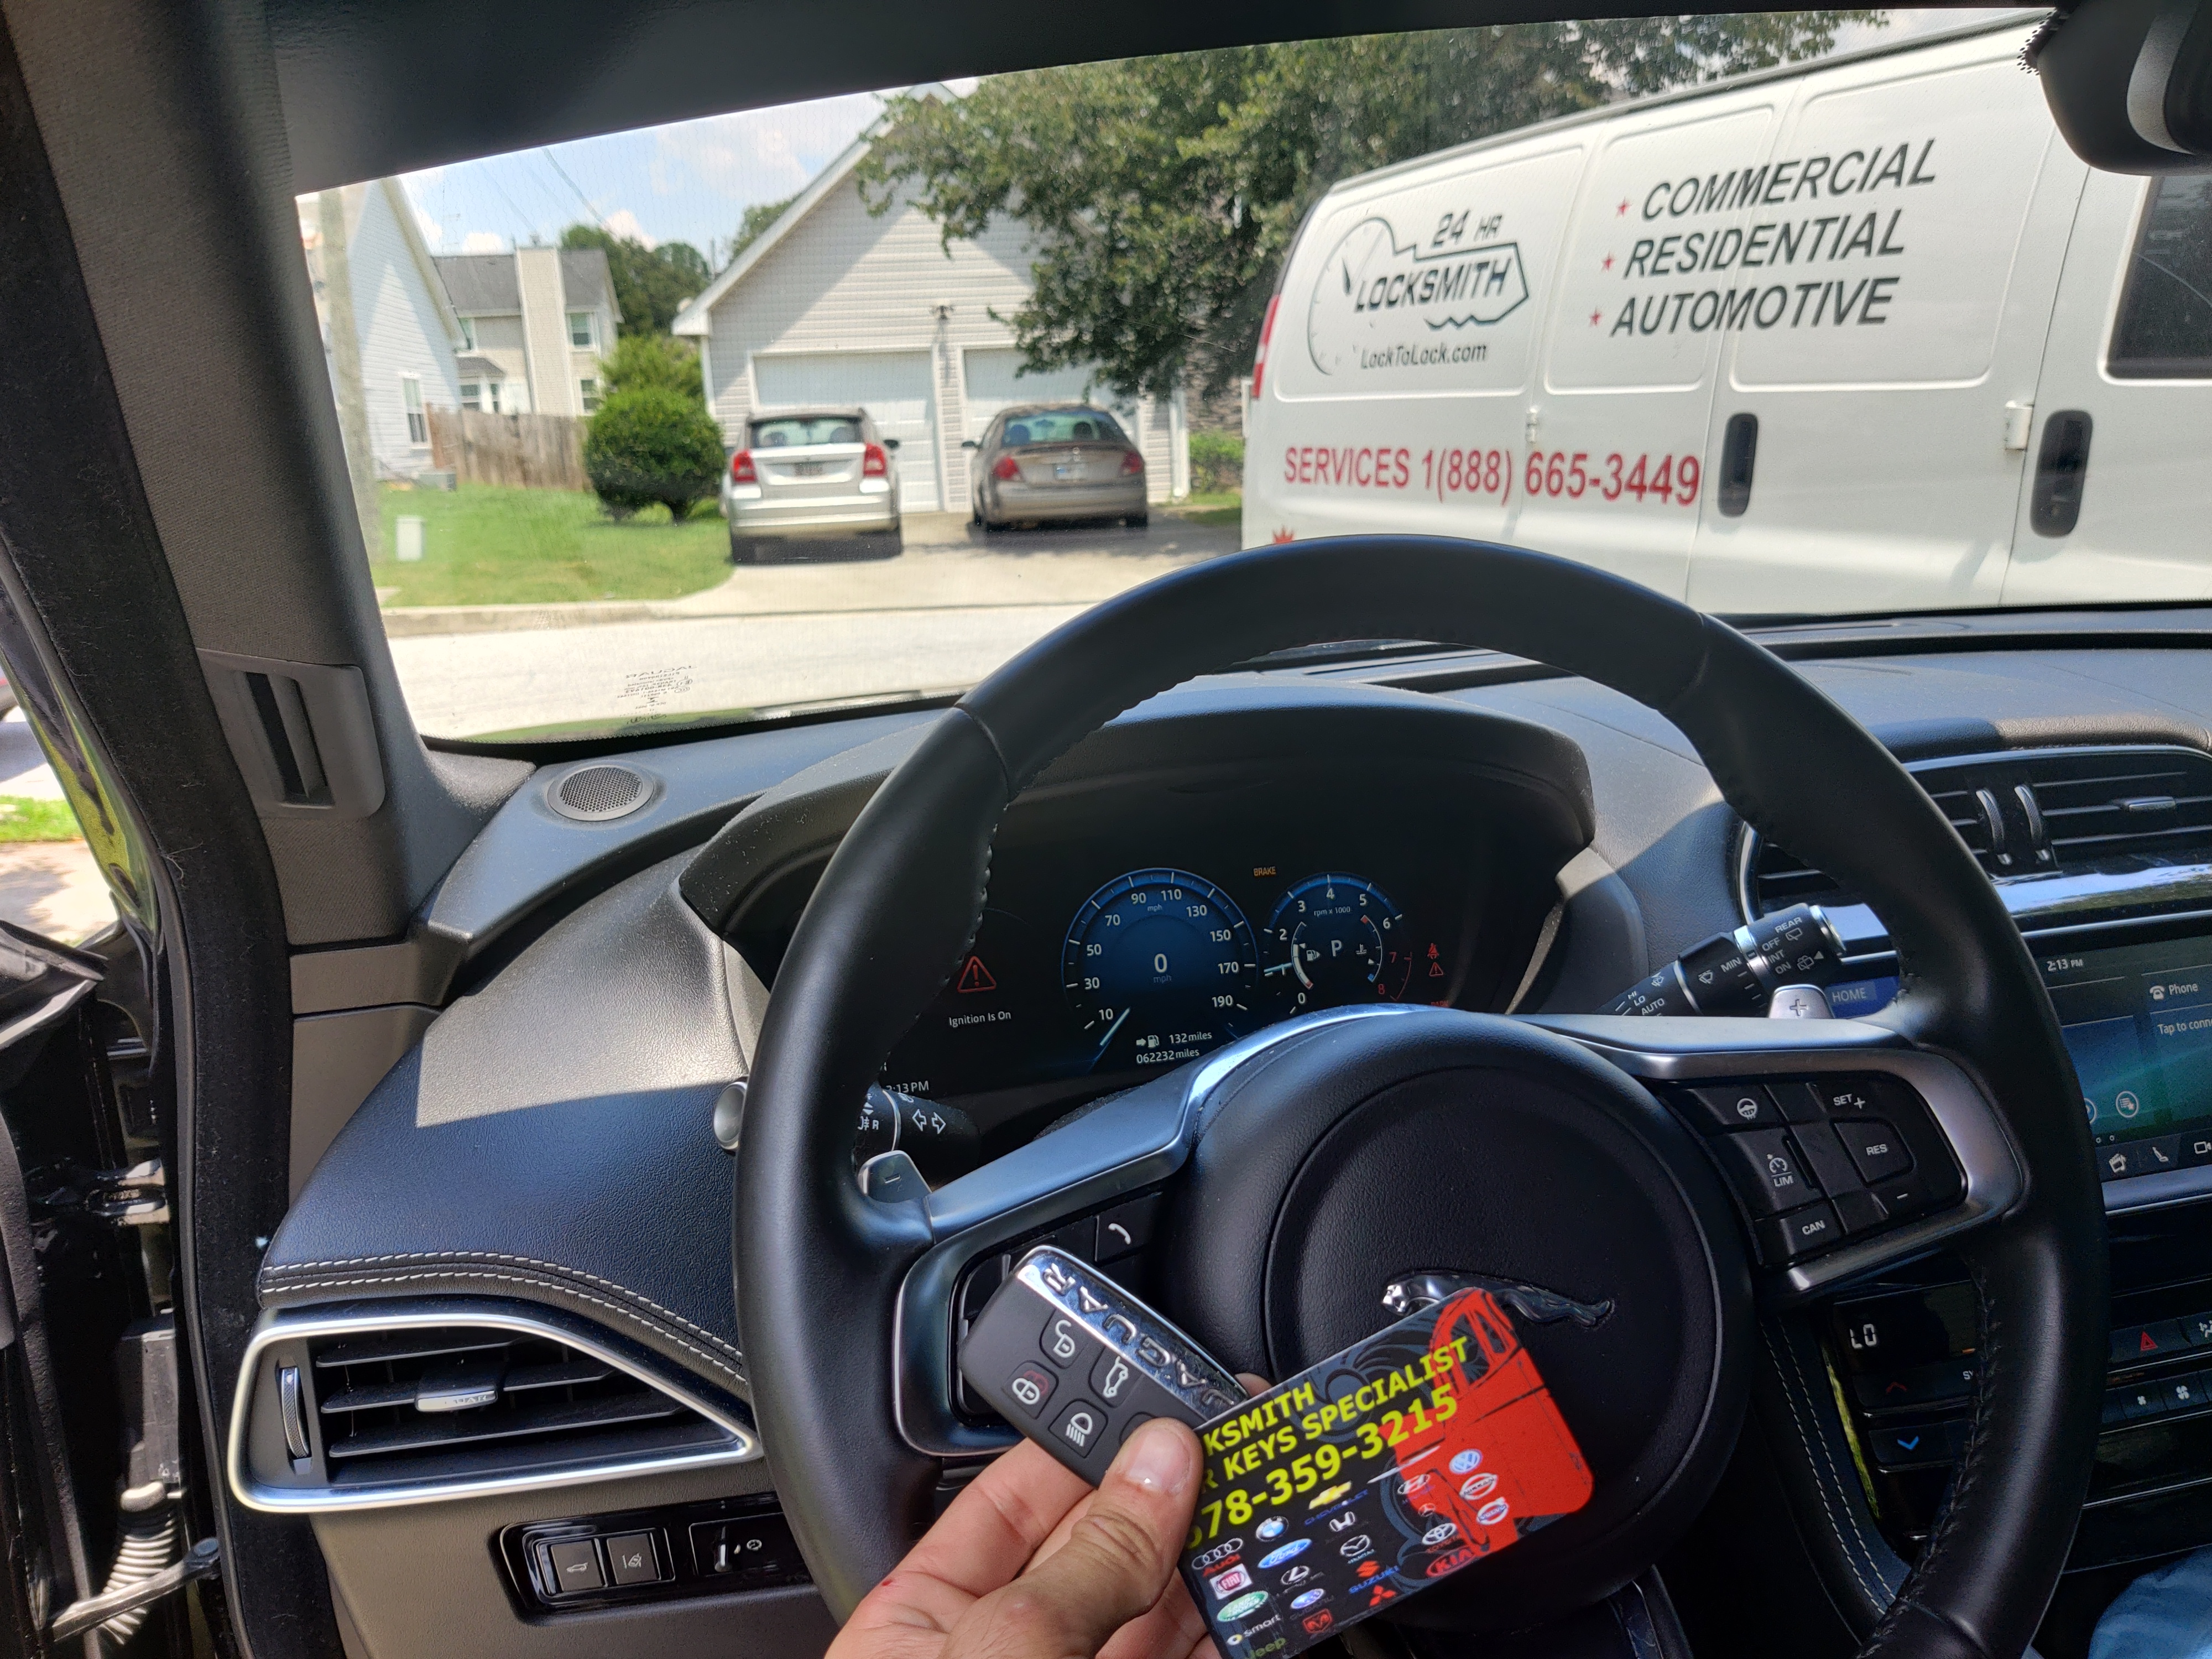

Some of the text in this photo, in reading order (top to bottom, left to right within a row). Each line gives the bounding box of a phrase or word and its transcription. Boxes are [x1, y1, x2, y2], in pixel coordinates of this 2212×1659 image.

[1642, 138, 1937, 221] COMMERCIAL
[1431, 210, 1503, 248] 24 HR
[1623, 209, 1905, 281] RESIDENTIAL
[1355, 257, 1512, 313] LOCKSMITH
[1609, 276, 1900, 337] AUTOMOTIVE
[1361, 342, 1488, 369] LockToLock.com
[1284, 446, 1700, 507] SERVICES 1(888) 665-3449
[1254, 867, 1276, 877] BRAKE
[1131, 893, 1146, 905] 90
[1161, 889, 1182, 901] 110
[1326, 888, 1334, 899] 4
[1359, 894, 1367, 906] 5
[1147, 904, 1162, 912] mph
[1186, 905, 1207, 917] 130
[1297, 900, 1306, 912] 3
[1314, 909, 1327, 917] rpm
[1105, 914, 1120, 926] 70
[1383, 917, 1391, 929] 6
[1775, 917, 1802, 933] REAR
[1210, 929, 1232, 942] 150
[1279, 928, 1287, 941] 2
[1087, 944, 1102, 956] 50
[1331, 940, 1342, 957] P
[1762, 937, 1780, 952] OFF
[1154, 953, 1167, 973] 0
[1389, 952, 1397, 963] 7
[1769, 950, 1786, 964] INT
[1218, 961, 1240, 974] 170
[1720, 957, 1742, 973] MIN
[1775, 961, 1791, 975] ON
[2047, 958, 2084, 972] 2:13 PM
[1084, 977, 1099, 990] 30
[1378, 984, 1385, 995] 8
[2168, 983, 2199, 995] Phone
[1212, 995, 1233, 1008] 190
[1298, 992, 1306, 1004] 0
[1634, 995, 1645, 1006] LO
[1832, 987, 1866, 1003] HOME
[1641, 998, 1665, 1015] AUTO
[949, 1011, 1011, 1027] Ignition Is On
[1099, 1008, 1113, 1020] 10
[2157, 1019, 2212, 1036] Tap to conn
[911, 1081, 929, 1092] PM
[1866, 1143, 1887, 1156] RES
[1773, 1174, 1793, 1187] LIM
[1802, 1220, 1825, 1235] CAN
[1042, 1262, 1237, 1407] JAGUAR
[1223, 1336, 1468, 1480] KEYS SPECIALIST
[1203, 1382, 1316, 1457] KSMITH
[1436, 1548, 1473, 1573] KIA
[1221, 1572, 1242, 1589] FIAT
[1348, 1565, 1401, 1594] SUZUKI
[1244, 1614, 1281, 1637] smart
